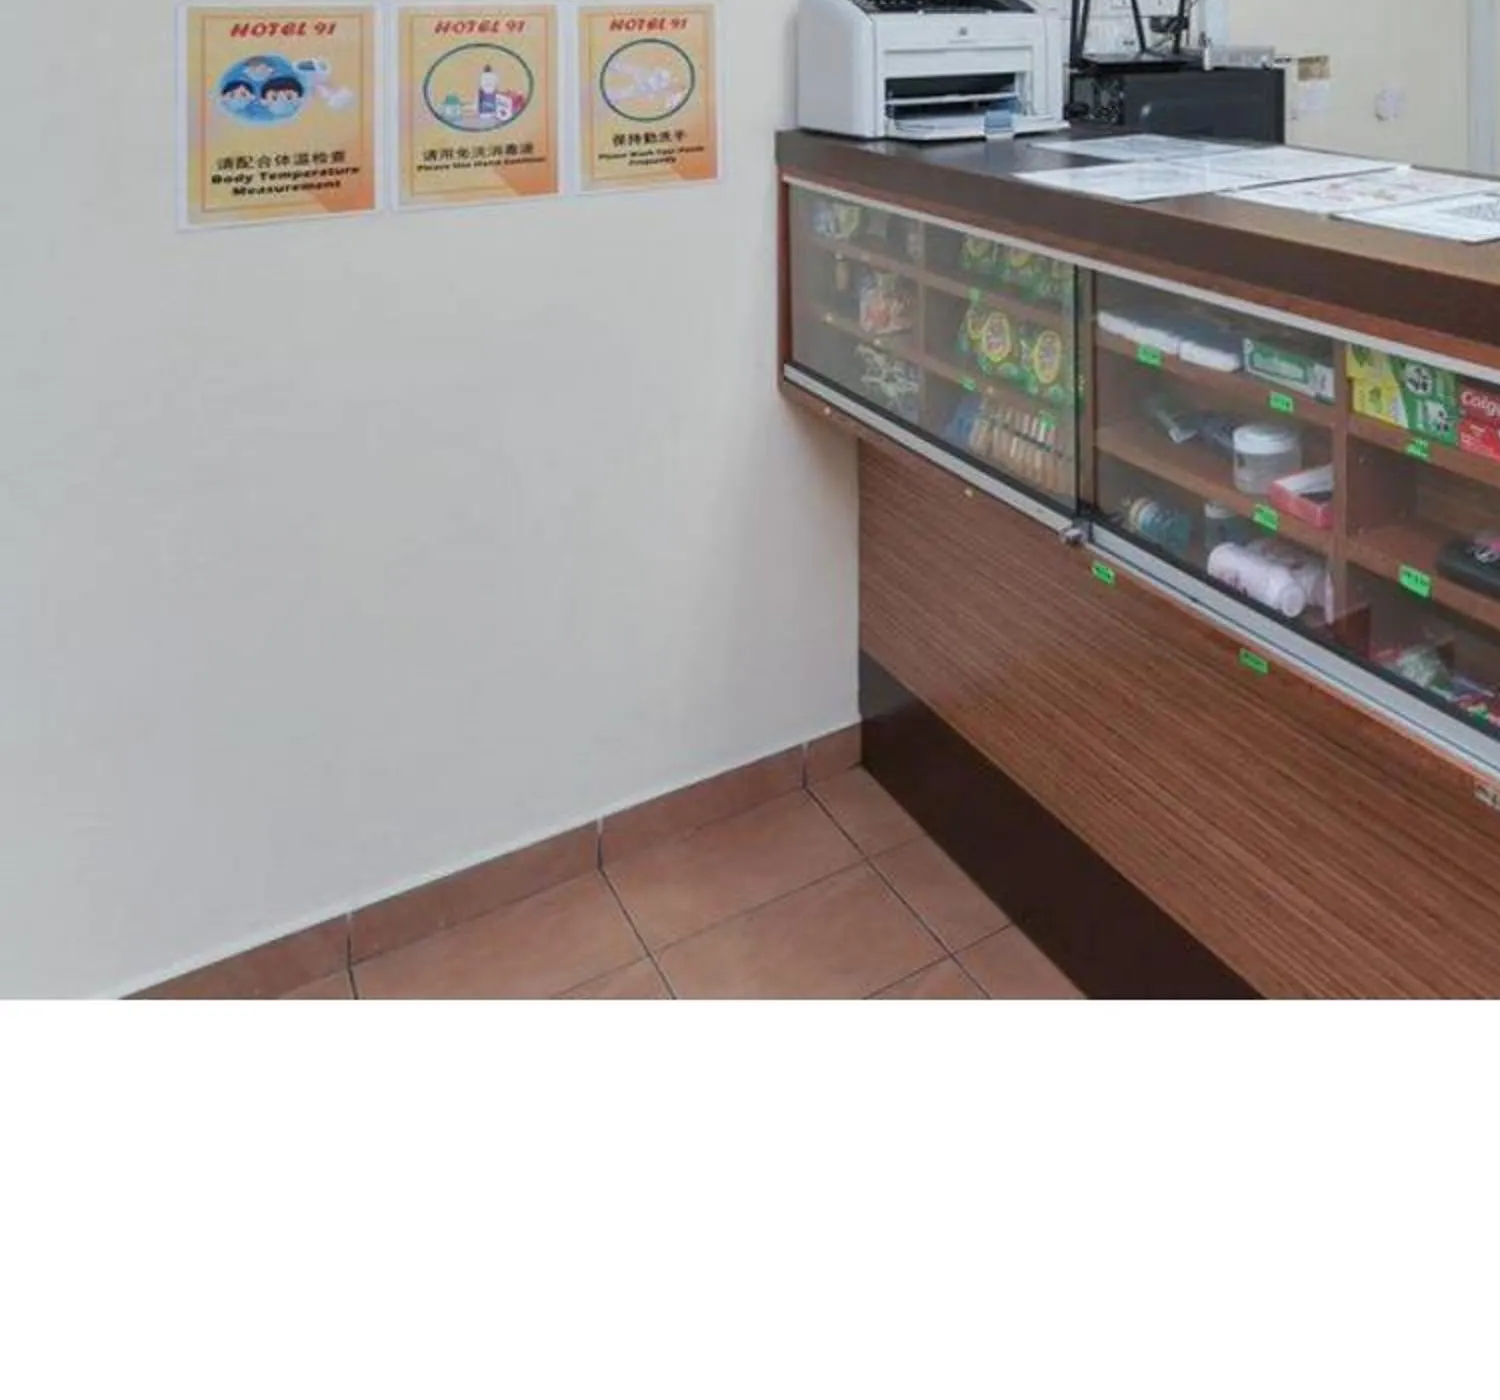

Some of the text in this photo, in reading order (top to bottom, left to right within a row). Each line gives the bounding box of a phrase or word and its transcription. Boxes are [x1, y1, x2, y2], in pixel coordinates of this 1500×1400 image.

[230, 20, 337, 37] HOTEL 91
[434, 19, 526, 34] HOTEL 91
[609, 18, 688, 32] HOTEL 91
[211, 166, 360, 185] Body Temperature
[232, 180, 342, 196] Measurement
